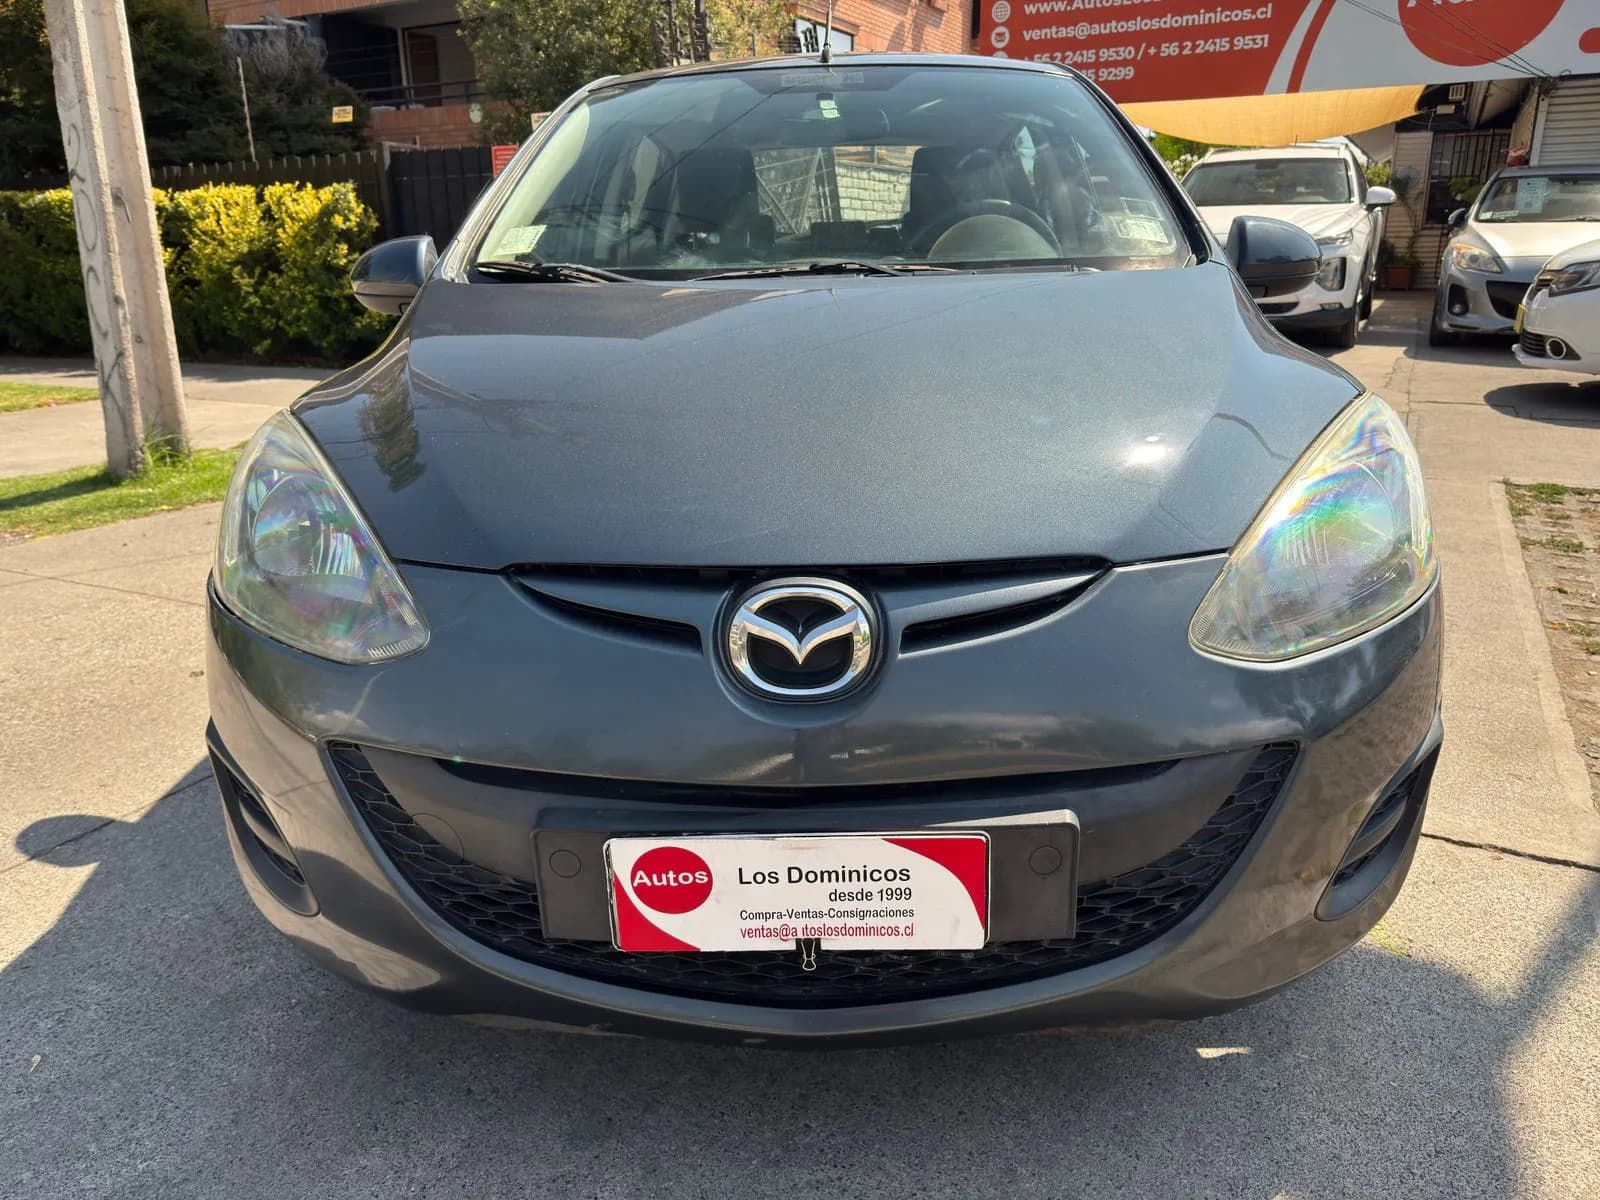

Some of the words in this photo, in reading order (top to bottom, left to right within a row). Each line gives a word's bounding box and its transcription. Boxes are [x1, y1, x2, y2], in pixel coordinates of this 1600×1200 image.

[1023, 3, 1272, 41] ventas@autoslosdominicos.cl
[1065, 50, 1096, 64] 2415
[1099, 46, 1135, 62] 9530
[1160, 42, 1180, 56] 56
[1182, 41, 1192, 55] 2
[1195, 37, 1230, 54] 2415
[1233, 34, 1269, 50] 9531
[1099, 66, 1135, 81] 9299
[632, 869, 709, 888] Autos
[738, 866, 780, 886] Los
[786, 864, 911, 886] Dominicos
[828, 888, 873, 903] desde
[877, 887, 912, 901] 1999
[739, 907, 915, 922] Compra-Ventas-Consignaciones
